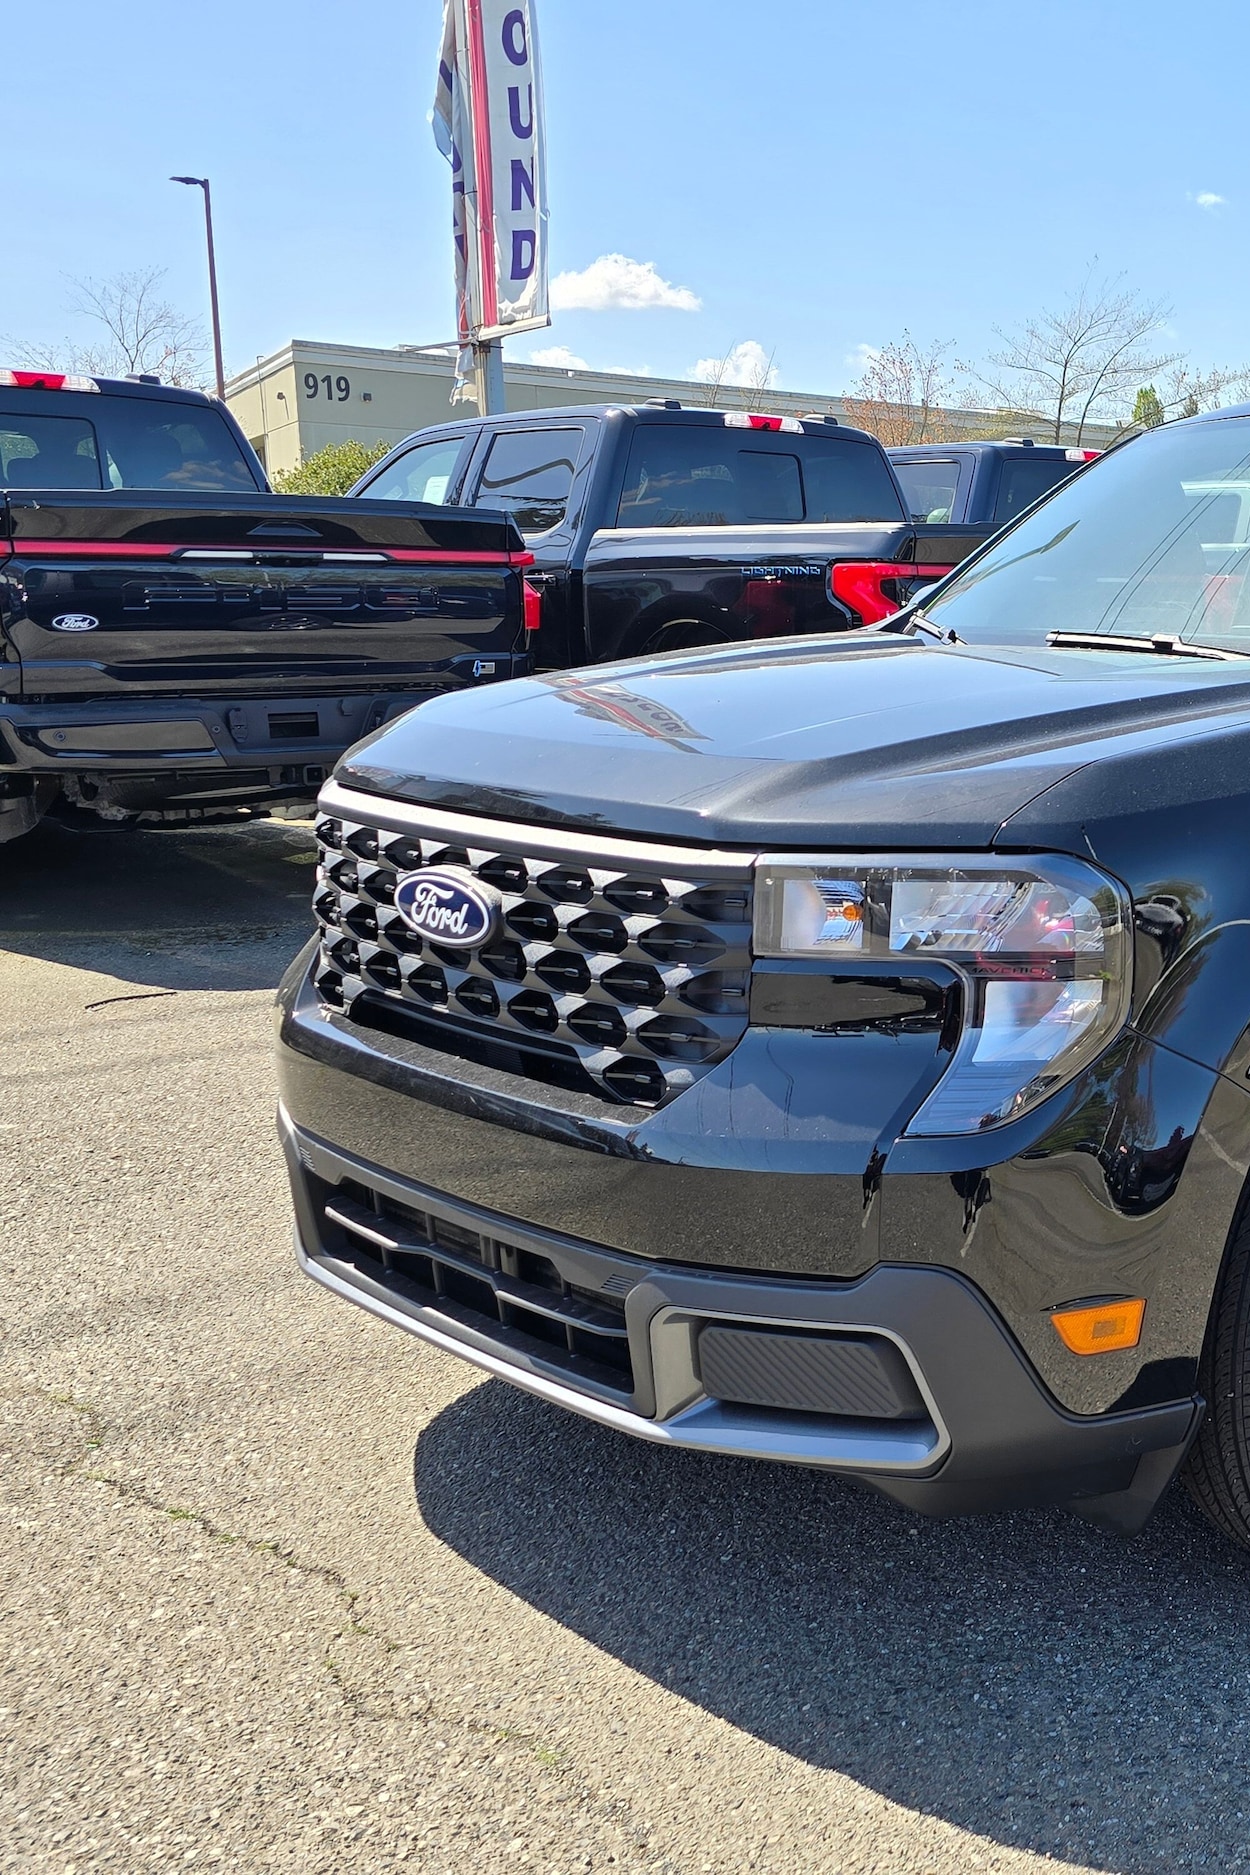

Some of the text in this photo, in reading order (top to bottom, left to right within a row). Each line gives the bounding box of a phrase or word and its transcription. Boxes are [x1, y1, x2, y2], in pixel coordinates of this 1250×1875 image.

[501, 8, 537, 281] OUND
[304, 372, 350, 402] 919
[740, 565, 821, 577] LIGHTNING
[411, 882, 470, 935] Ford
